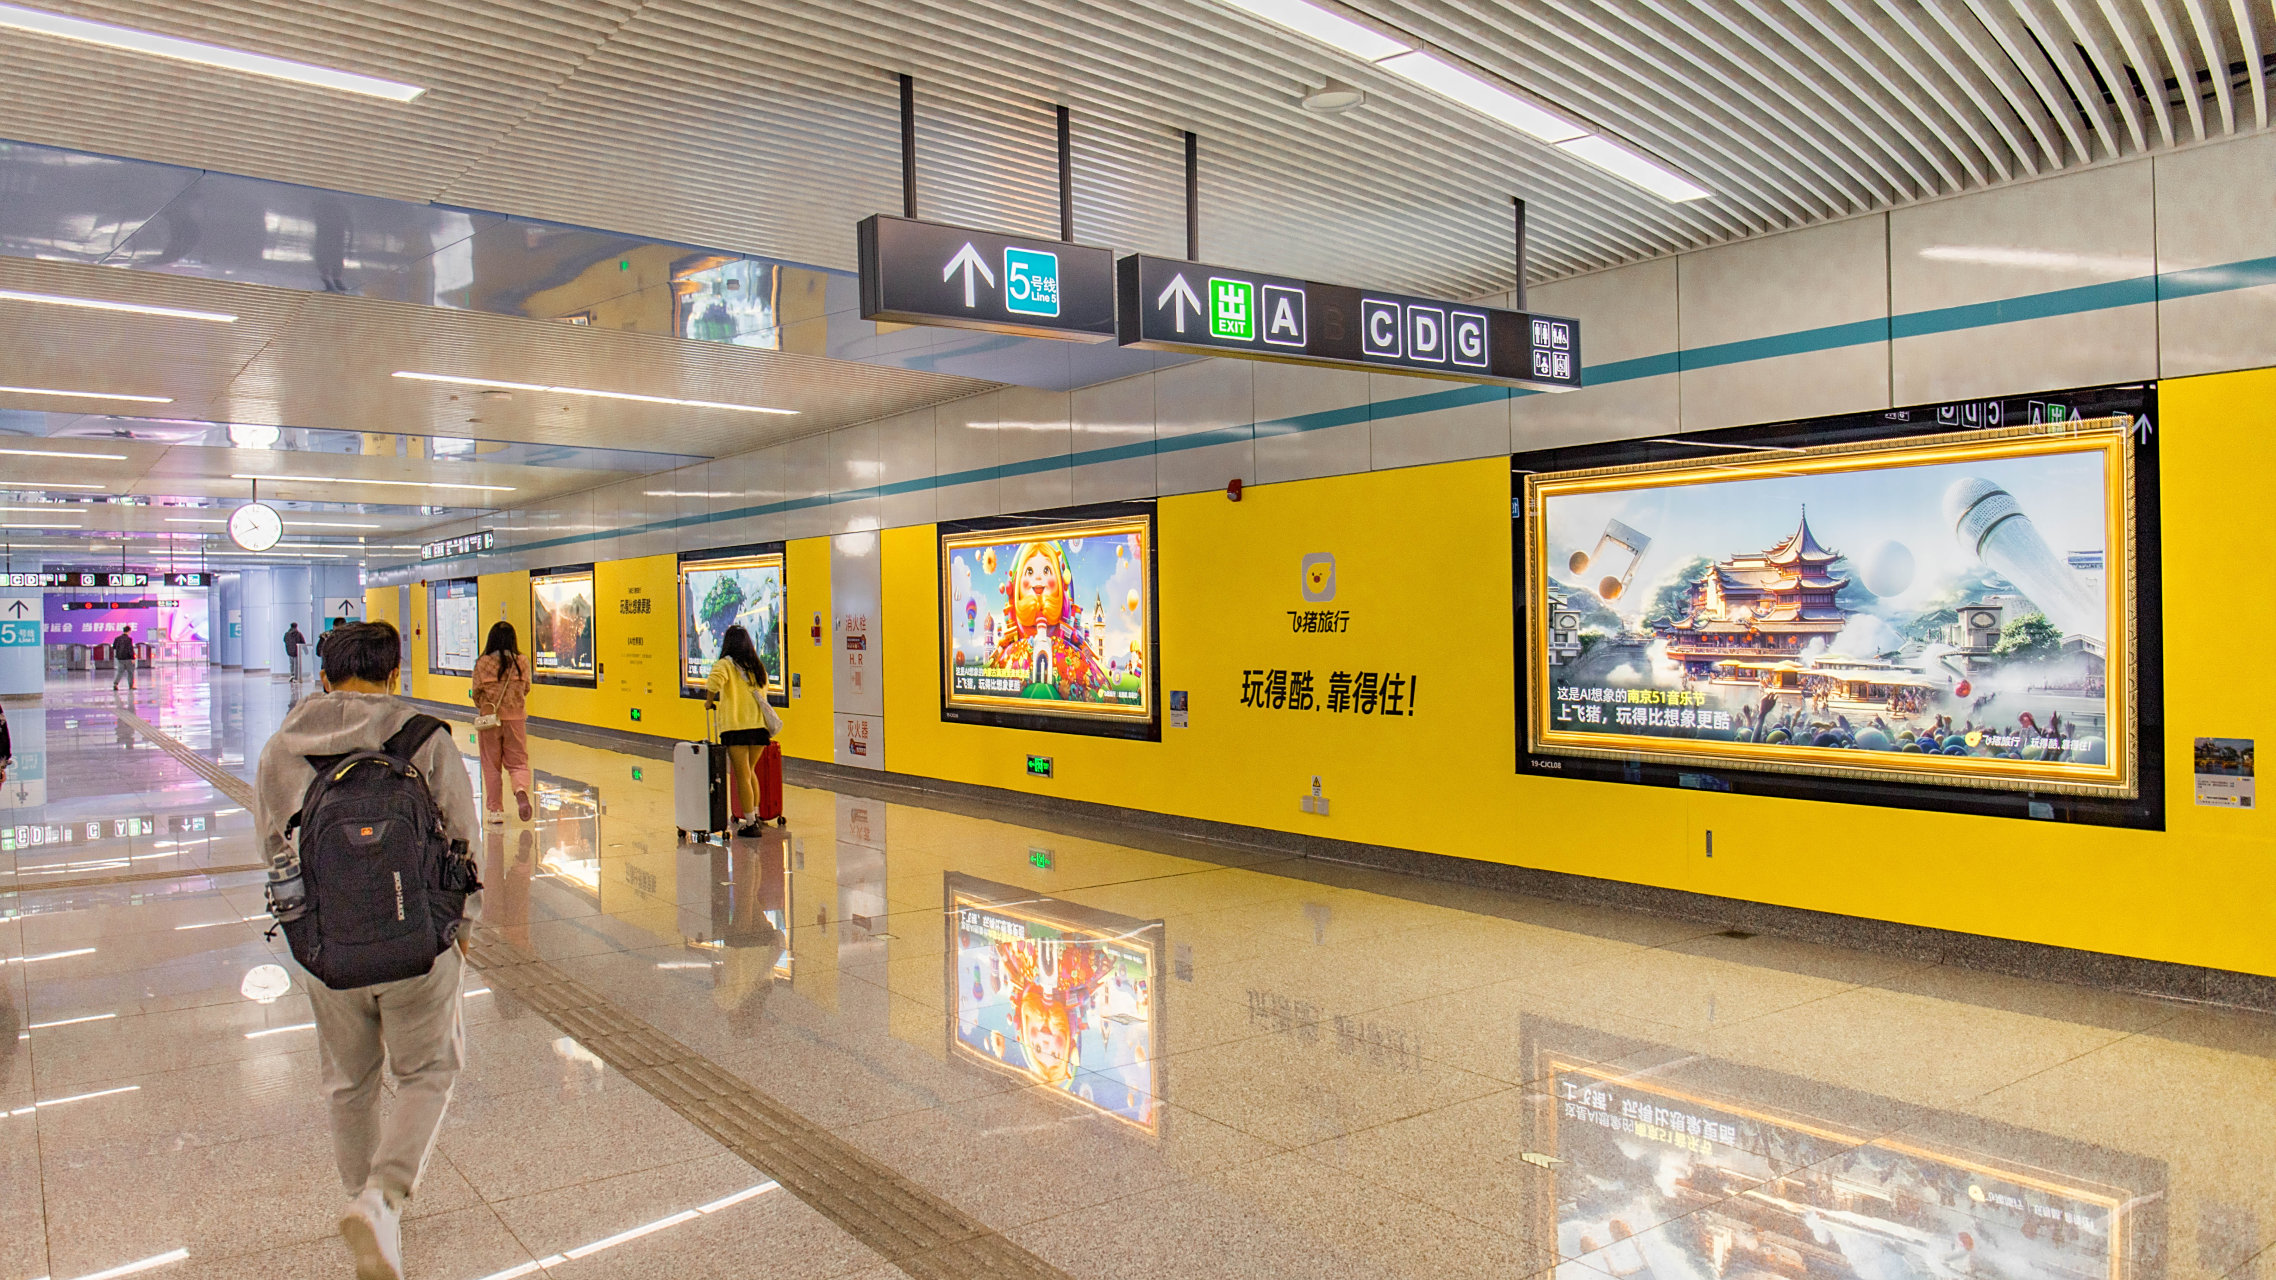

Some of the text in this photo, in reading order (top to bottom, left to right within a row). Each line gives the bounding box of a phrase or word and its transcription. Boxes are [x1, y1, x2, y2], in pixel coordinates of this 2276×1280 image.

[1031, 292, 1057, 303] Line 5
[1218, 284, 1245, 319] 出
[1218, 319, 1246, 334] EXIT
[1271, 297, 1299, 336] A
[1370, 310, 1393, 347] C
[1416, 316, 1437, 351] D
[1458, 322, 1481, 357] G
[845, 614, 867, 632] 消火栓
[1287, 610, 1350, 633] 飞猪旅行
[1557, 686, 1706, 707] 这是AI想象的南京51音乐节
[847, 720, 869, 739] 灭火器
